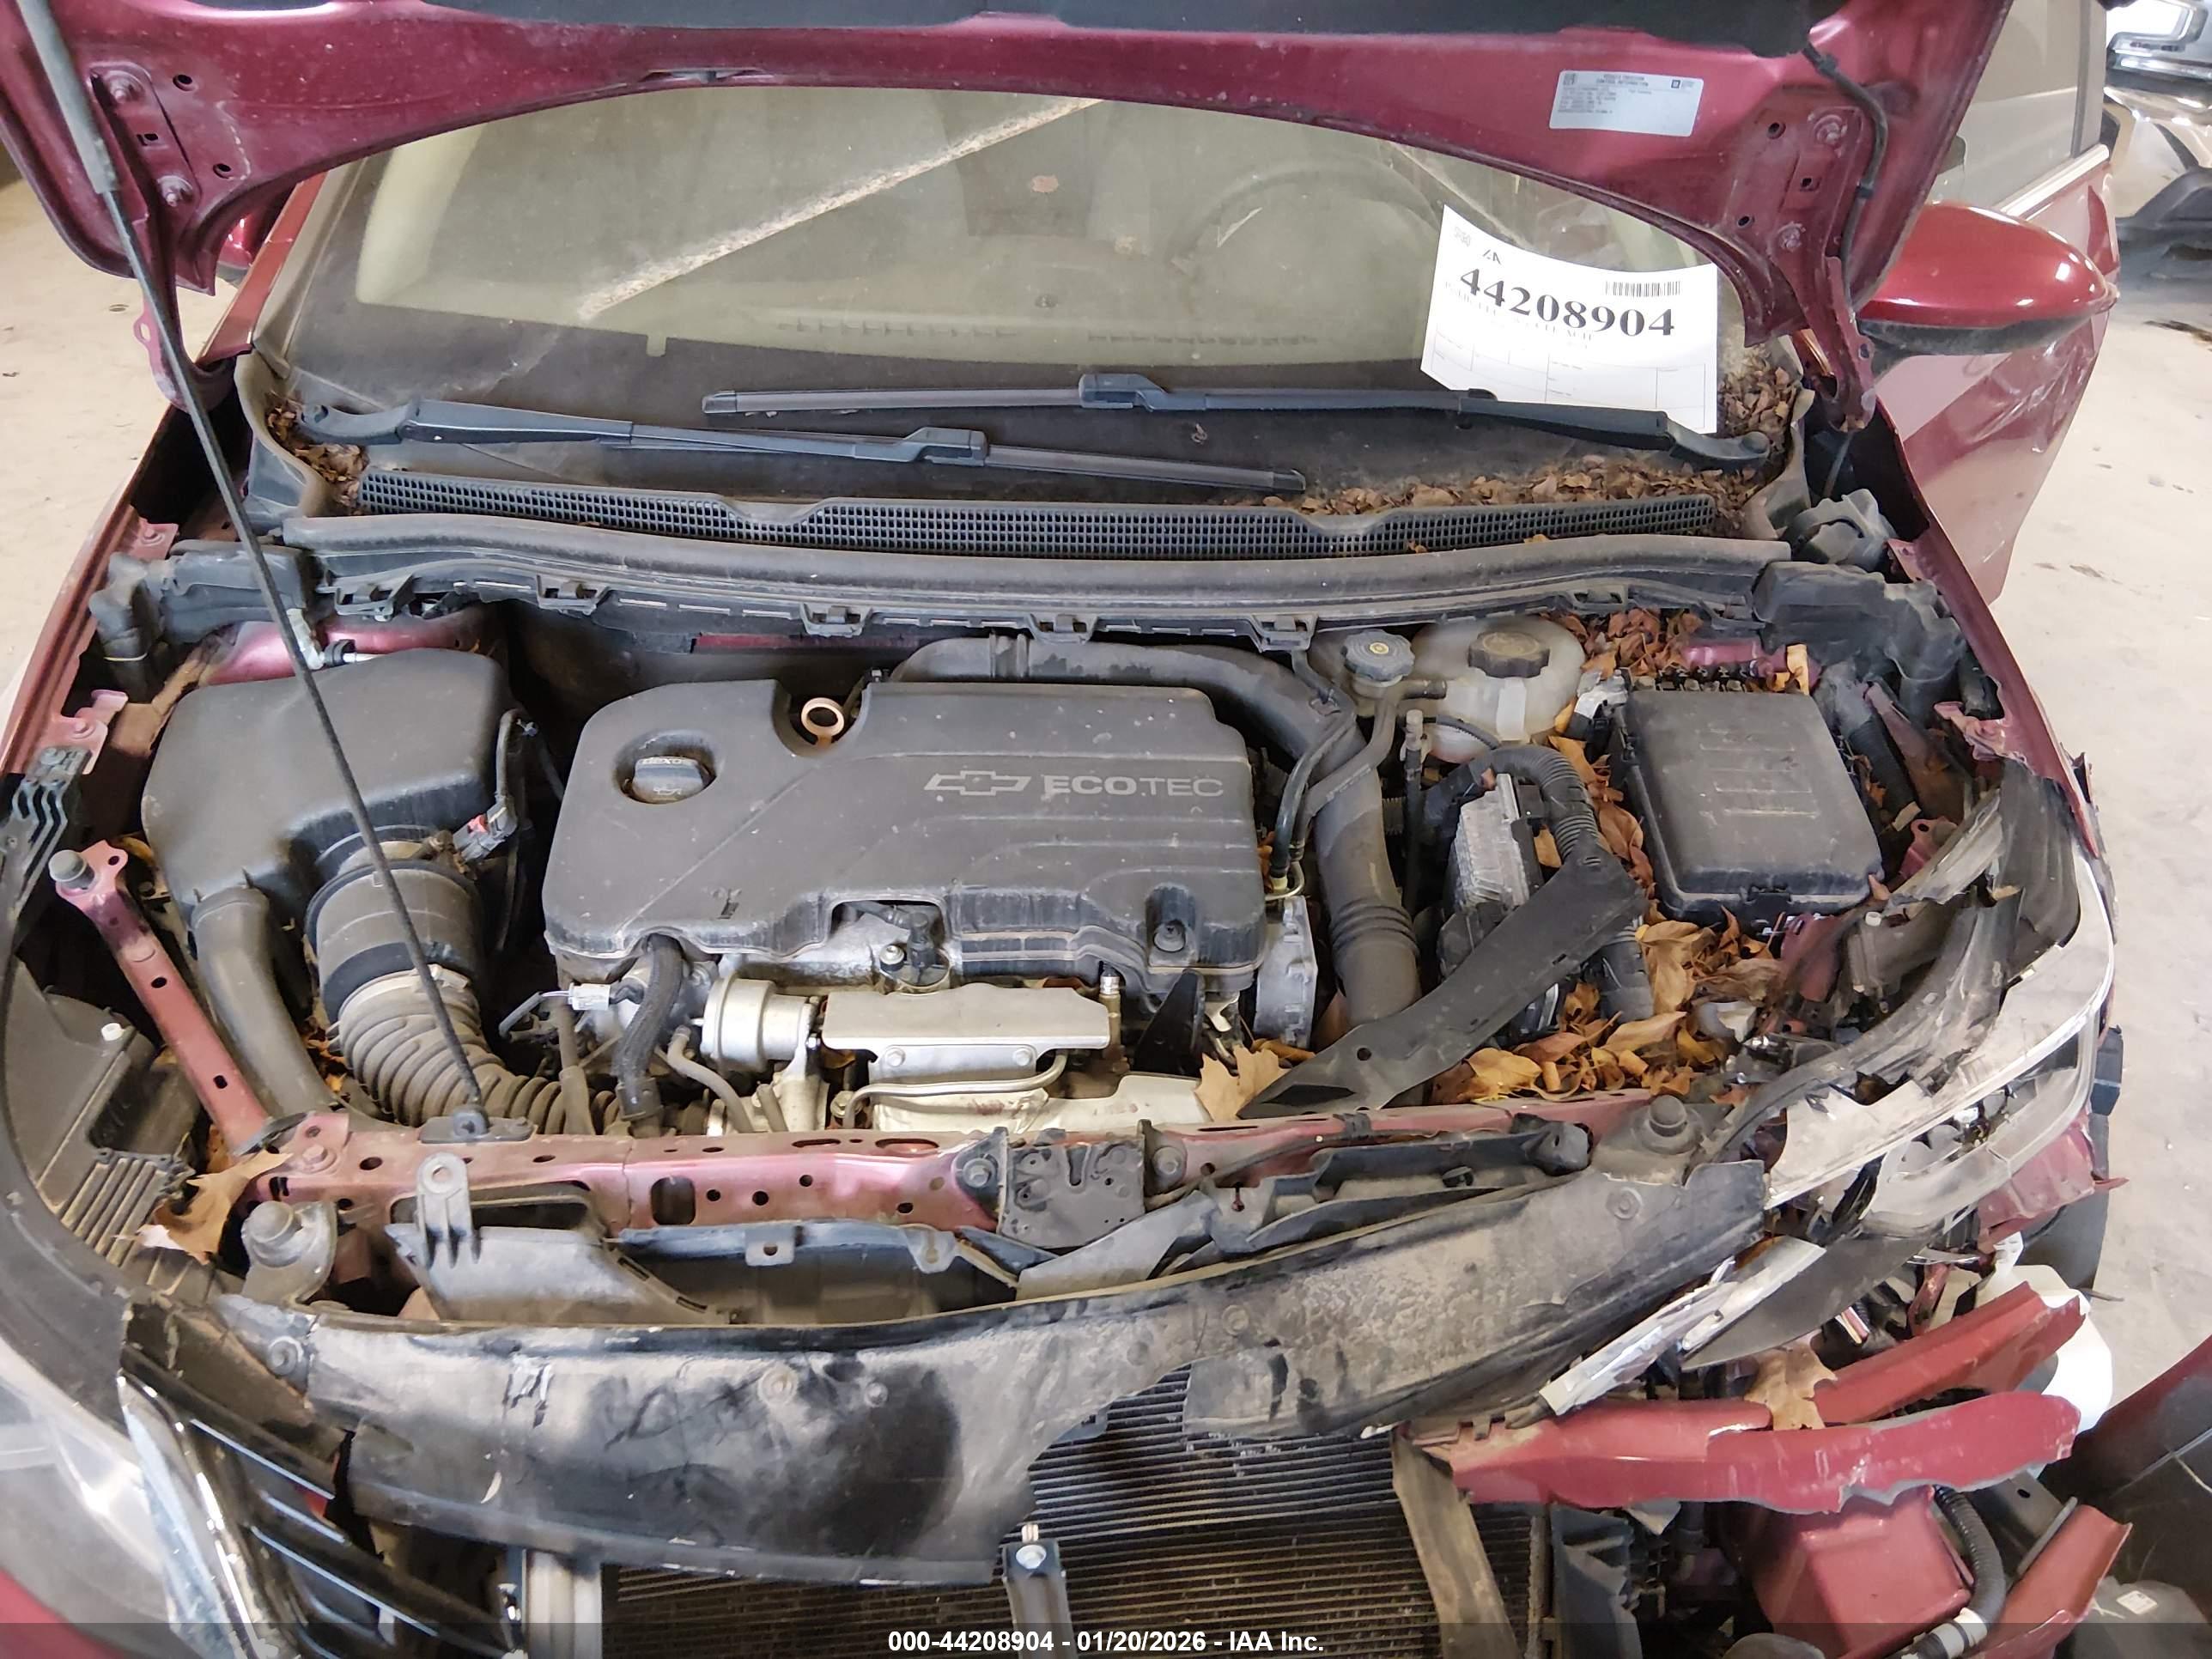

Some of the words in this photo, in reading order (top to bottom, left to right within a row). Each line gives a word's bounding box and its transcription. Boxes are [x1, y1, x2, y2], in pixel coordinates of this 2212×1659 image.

[1460, 268, 1675, 337] 44208904
[641, 757, 690, 765] dexo
[1043, 775, 1224, 797] ECOTEC
